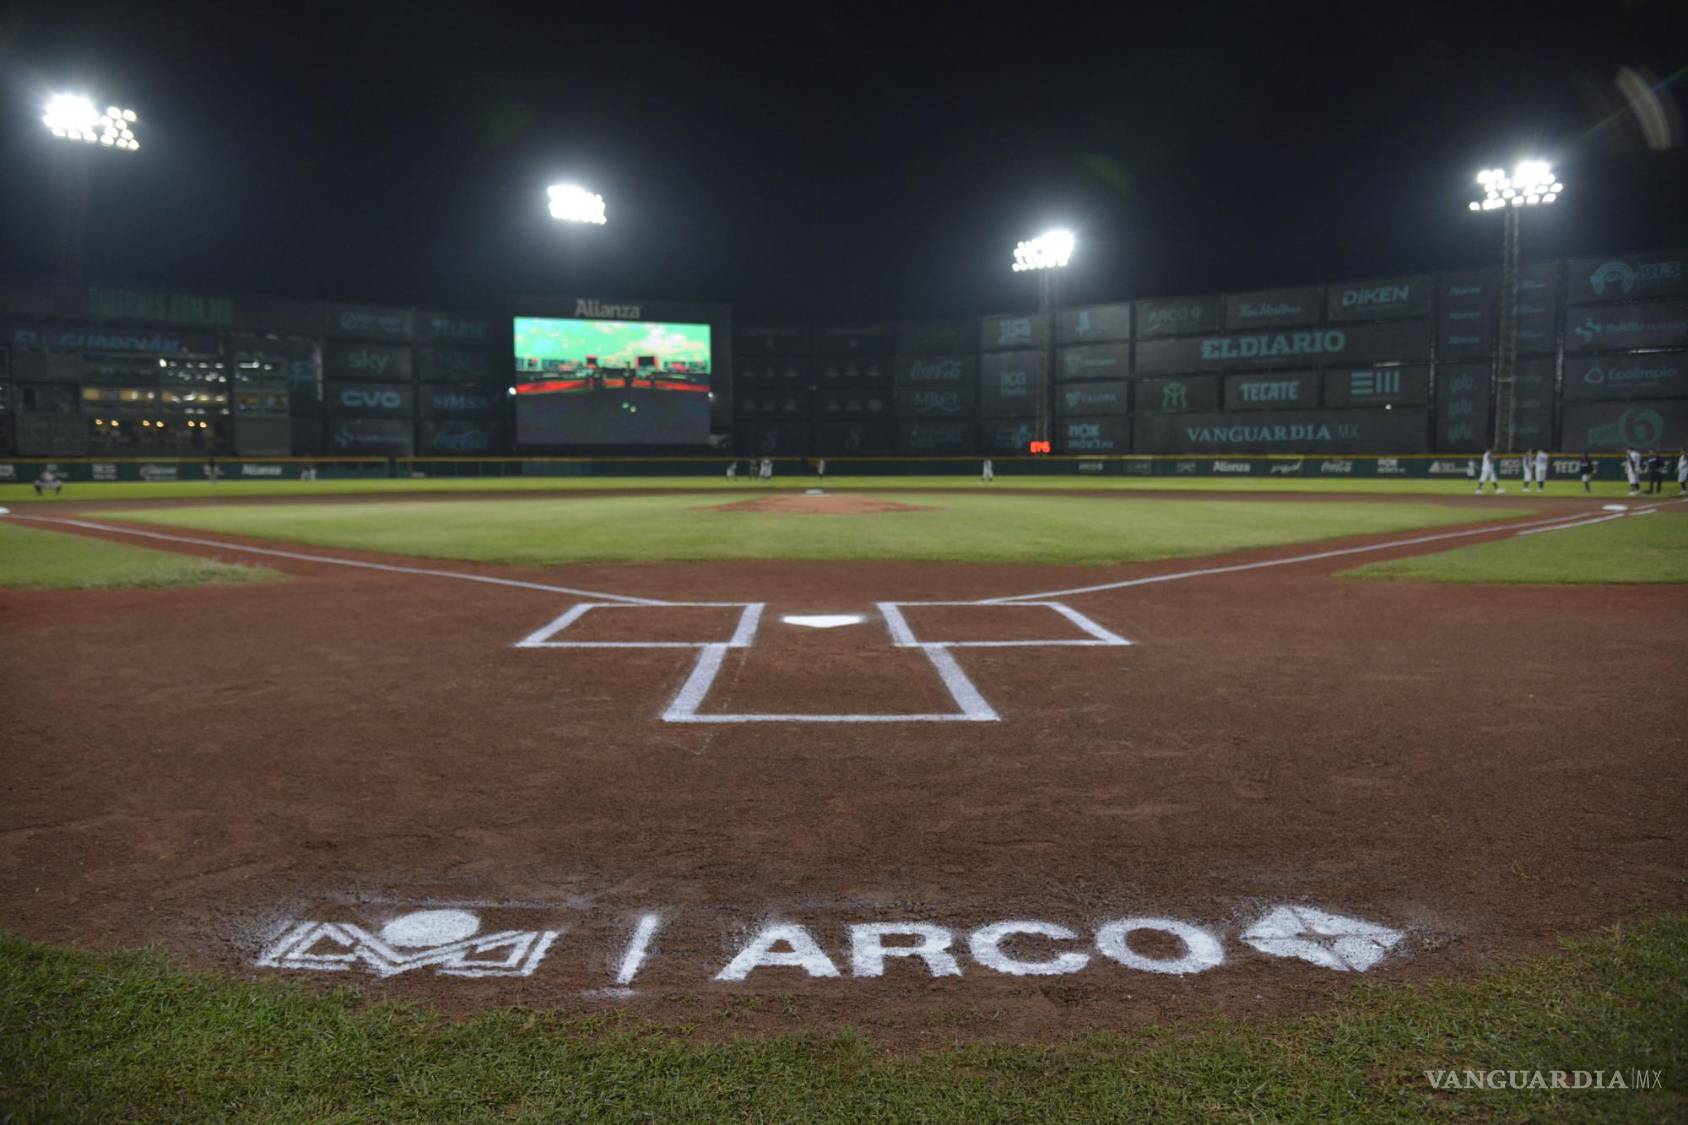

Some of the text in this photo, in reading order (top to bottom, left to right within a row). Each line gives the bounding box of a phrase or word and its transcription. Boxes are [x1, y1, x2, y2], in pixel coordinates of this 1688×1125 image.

[575, 298, 641, 319] Alianza
[1201, 330, 1346, 359] EL DIARIO
[349, 350, 390, 373] sky
[1241, 381, 1301, 401] TECATE
[1186, 424, 1332, 442] VANGUARDIA
[1212, 461, 1252, 474] Alianza
[715, 921, 1227, 982] ARCO
